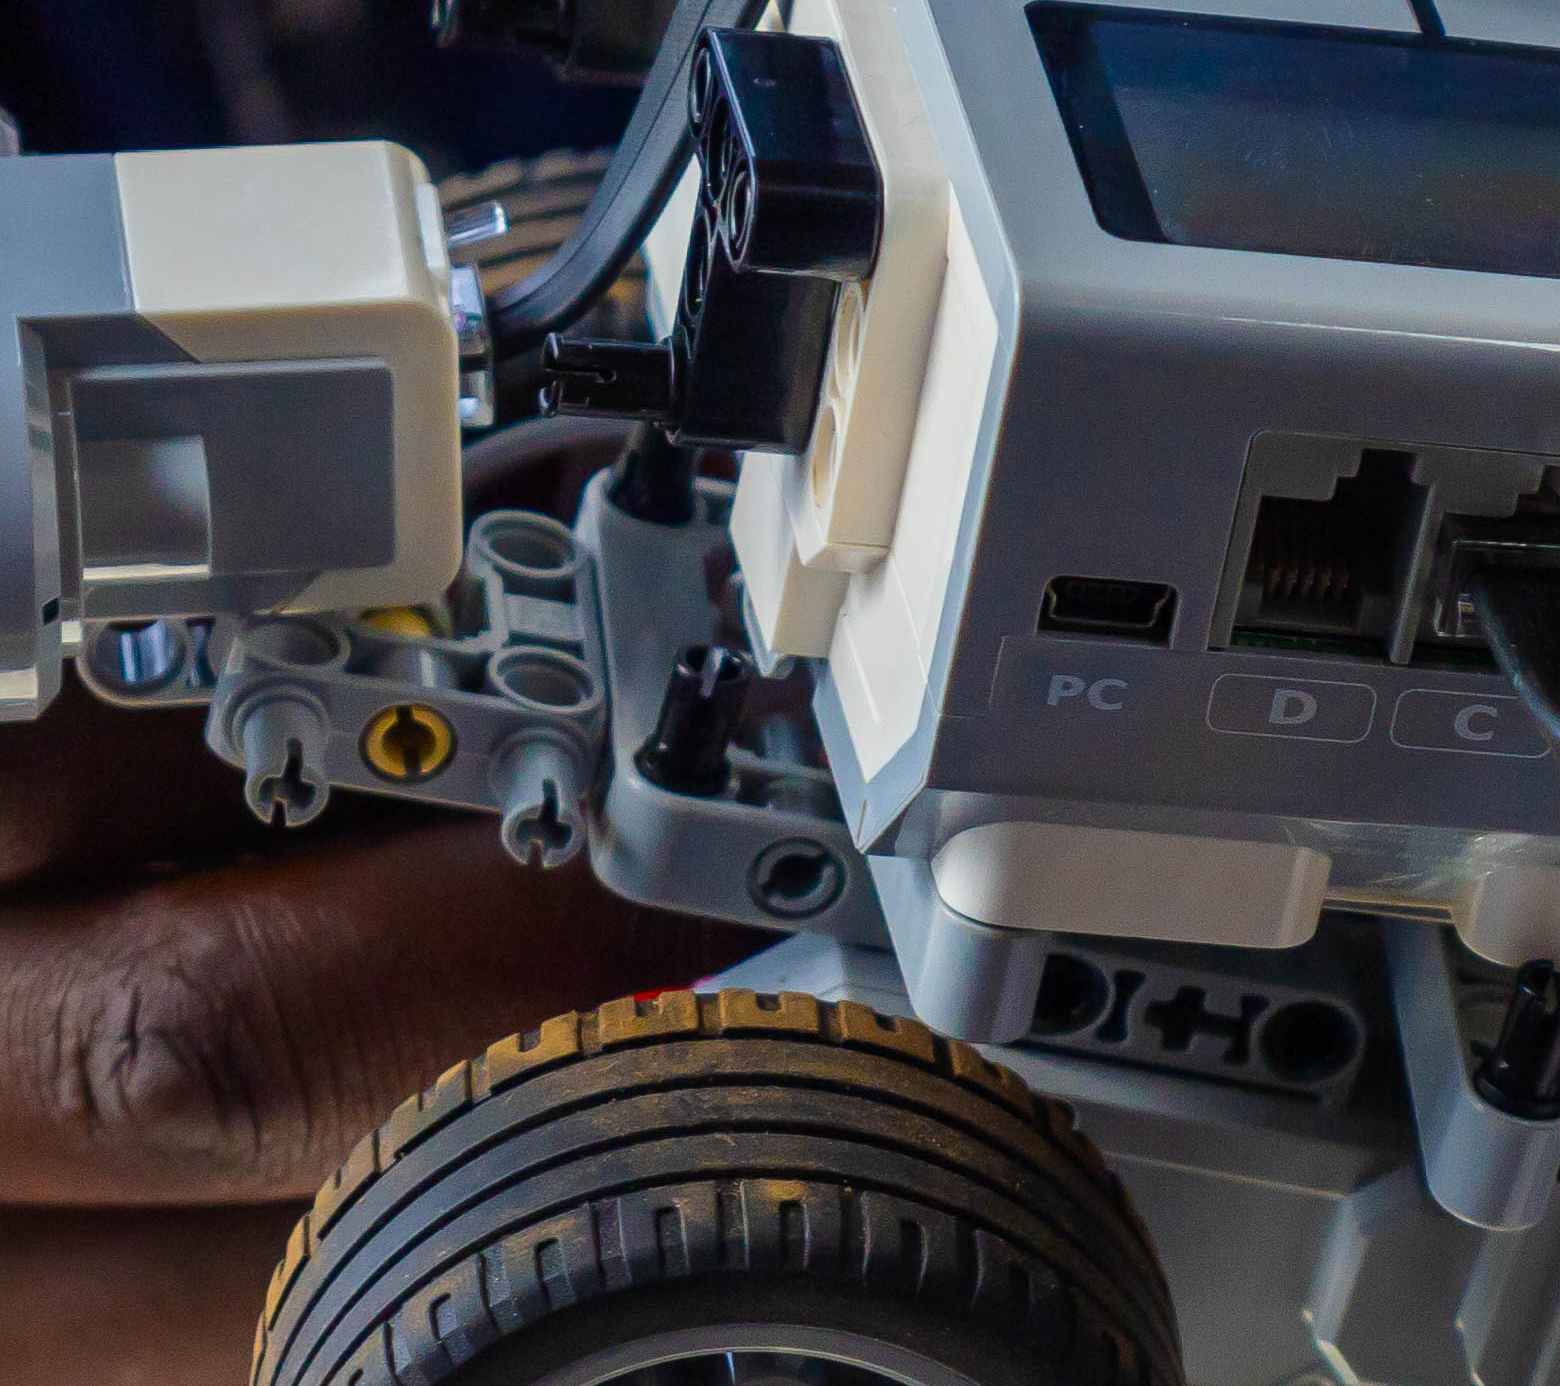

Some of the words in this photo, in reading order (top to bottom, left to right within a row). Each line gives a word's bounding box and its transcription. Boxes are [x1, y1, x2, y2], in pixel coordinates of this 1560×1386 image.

[1046, 674, 1128, 711] PC
[1268, 688, 1317, 725] D
[1453, 704, 1498, 741] C
